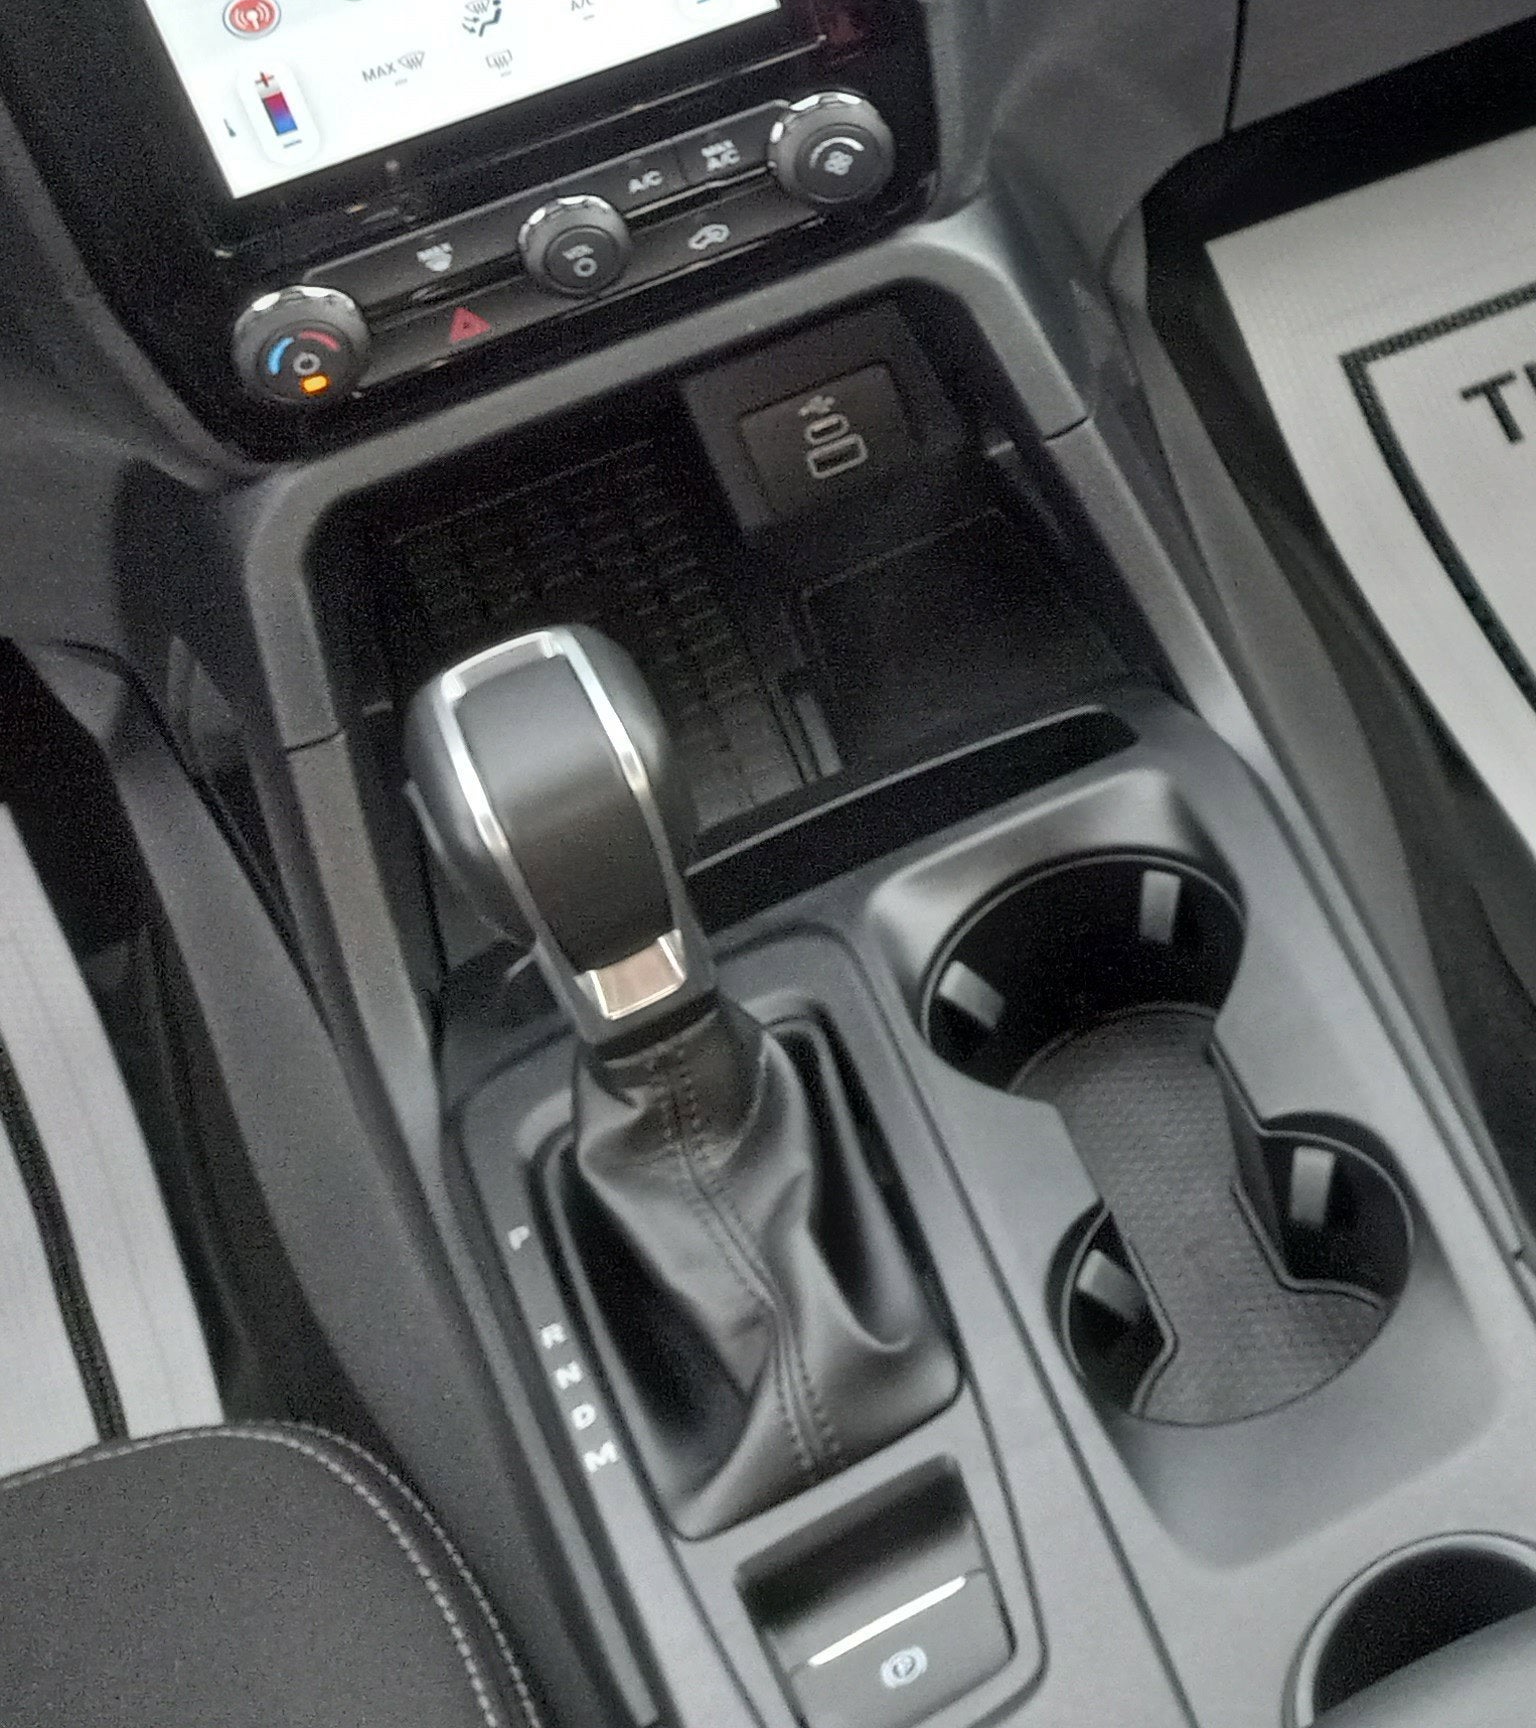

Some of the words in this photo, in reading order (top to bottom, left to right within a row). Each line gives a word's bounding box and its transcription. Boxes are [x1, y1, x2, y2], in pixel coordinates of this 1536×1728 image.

[362, 61, 399, 84] MAX
[628, 169, 664, 194] A/C
[540, 1322, 568, 1349] R
[554, 1361, 584, 1390] N
[571, 1402, 596, 1431] D
[584, 1440, 618, 1473] M
